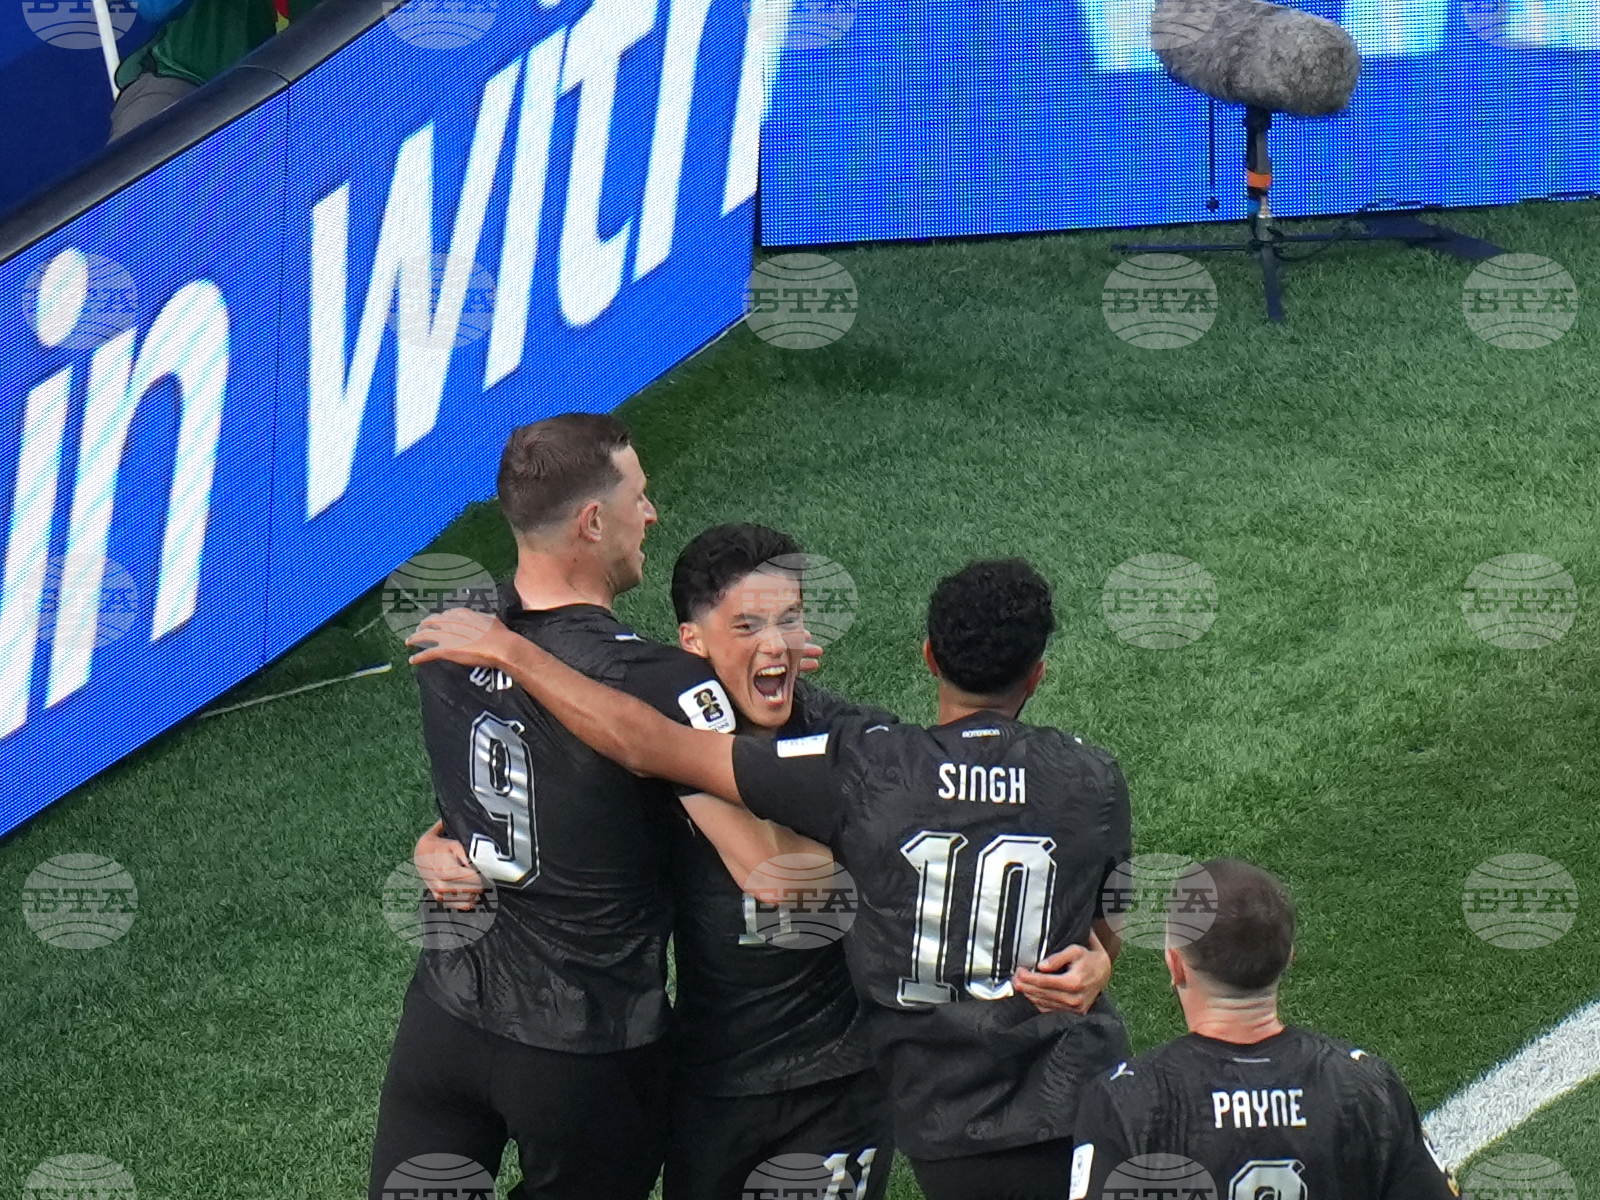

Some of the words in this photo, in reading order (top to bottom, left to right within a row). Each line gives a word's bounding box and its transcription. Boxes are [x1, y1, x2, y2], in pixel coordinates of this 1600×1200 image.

[469, 710, 541, 890] 9
[938, 762, 1026, 804] SINGH
[897, 830, 1058, 1007] 10
[1211, 1088, 1307, 1129] PAYNE
